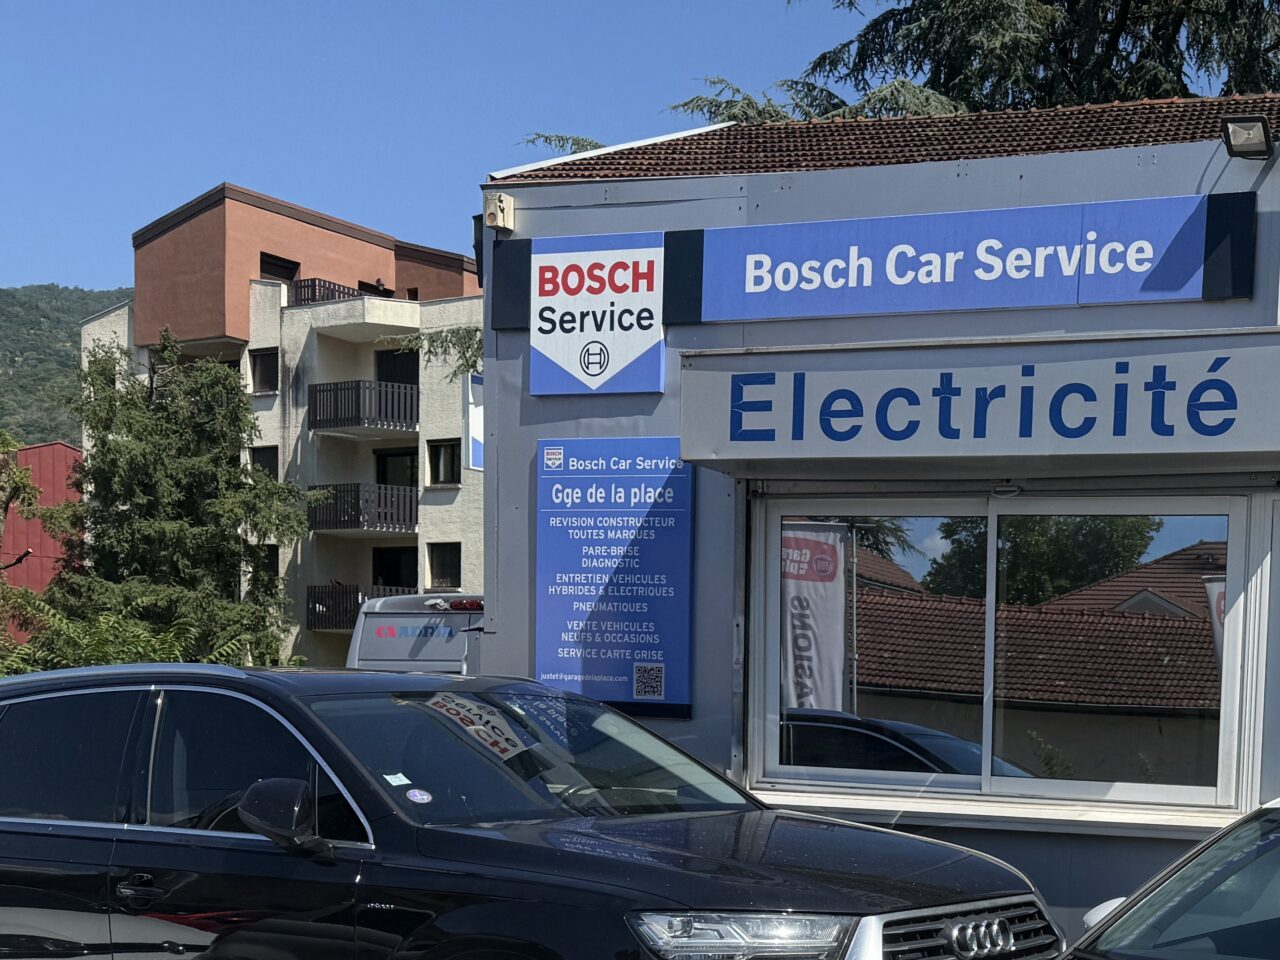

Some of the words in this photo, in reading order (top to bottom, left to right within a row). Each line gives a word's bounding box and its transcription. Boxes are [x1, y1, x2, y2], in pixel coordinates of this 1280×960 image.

[744, 245, 873, 294] Bosch
[885, 243, 965, 287] Car
[974, 230, 1155, 282] Service
[538, 260, 655, 297] BOSCH
[537, 301, 654, 335] Service
[729, 356, 1239, 443] Electricité
[569, 457, 606, 470] Bosch
[610, 457, 632, 470] Car
[636, 456, 684, 470] Service
[552, 484, 582, 508] Gge
[587, 483, 605, 503] de
[611, 483, 625, 503] la
[630, 483, 674, 508] place
[550, 517, 594, 527] REVISION
[597, 517, 676, 527] CONSTRUCTEUR
[568, 529, 605, 539] TOUTES
[608, 530, 656, 540] MARQUES
[582, 546, 640, 556] PARE-BRISE
[582, 558, 640, 568] DIAGNOSTIC
[556, 573, 609, 584] ENTRETIEN
[612, 574, 667, 584] VEHICULES
[548, 586, 596, 595] HYBRIDES
[599, 586, 605, 596] &
[608, 586, 675, 597] ELECTRIQUES
[573, 602, 648, 612] PNEUMATIQUES
[567, 620, 598, 631] VENTE
[600, 621, 655, 632] VEHICULES
[561, 632, 593, 642] NEUFS
[595, 633, 601, 642] &
[604, 633, 660, 644] OCCASIONS
[558, 648, 598, 658] SERVICE
[600, 649, 632, 659] CARTE
[634, 650, 664, 660] GRISE
[540, 672, 629, 682] justet@garagedelaplace.com
